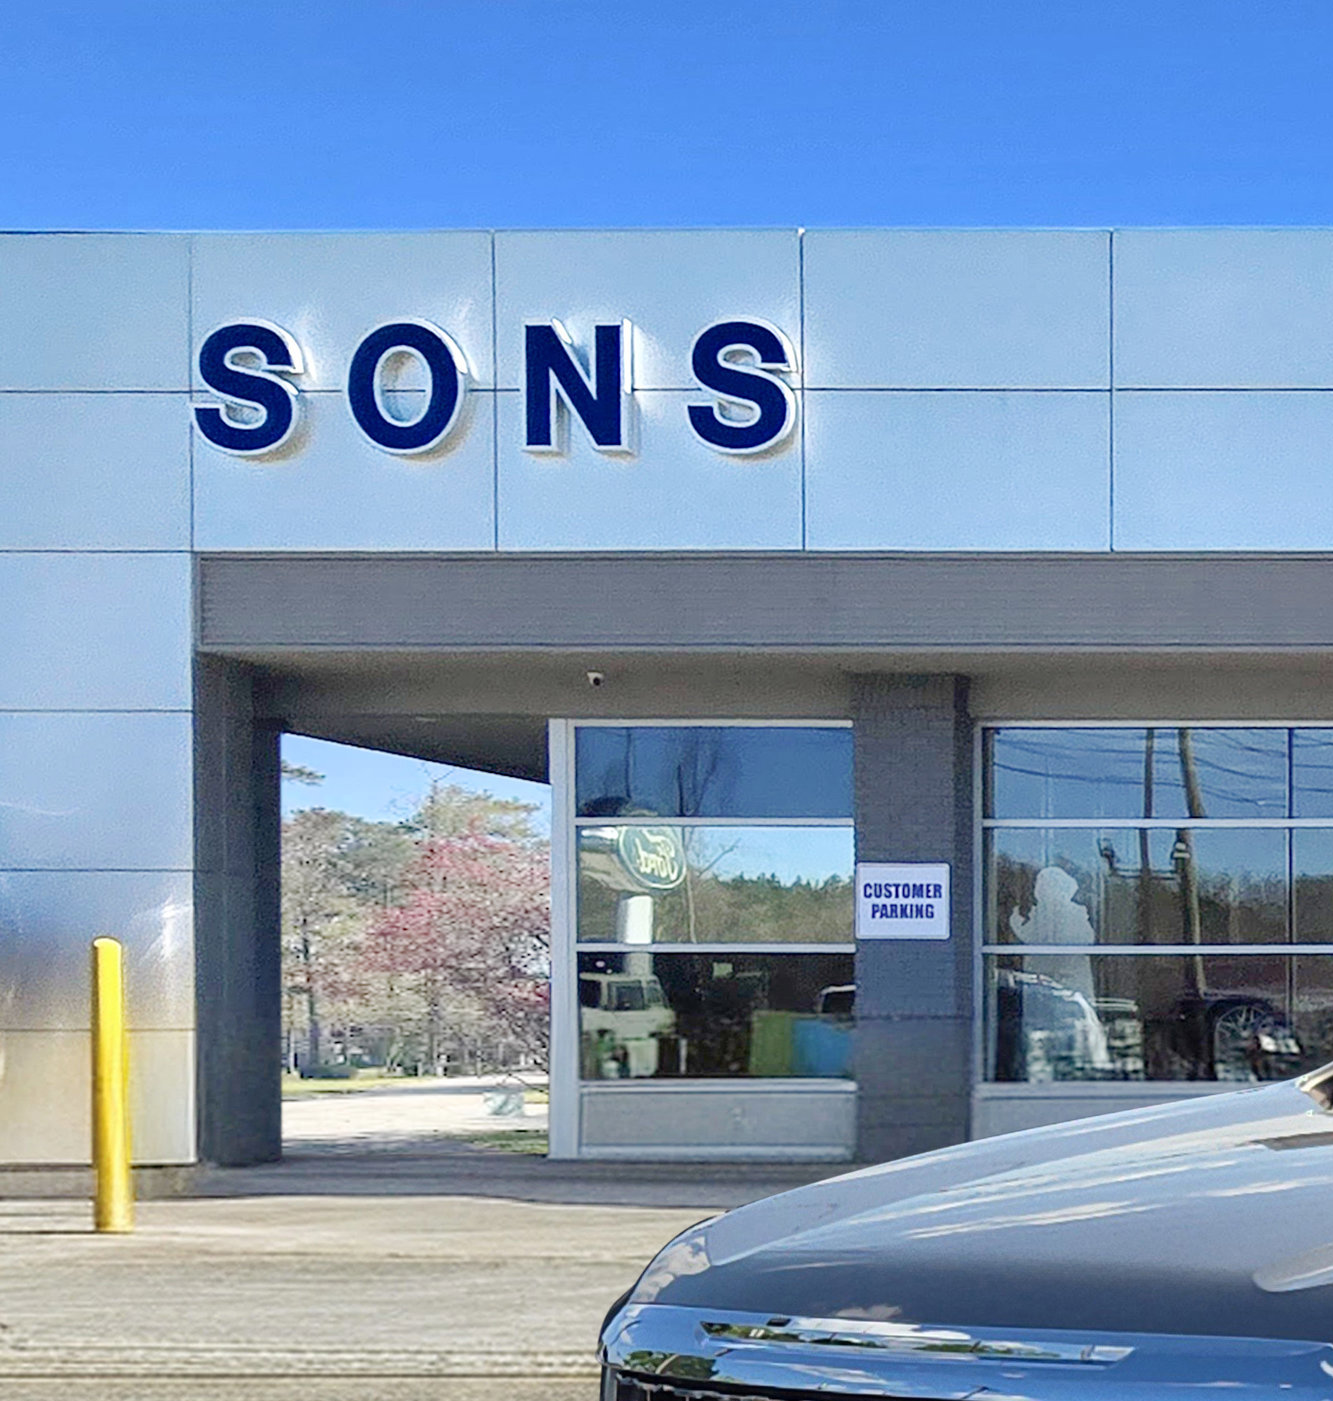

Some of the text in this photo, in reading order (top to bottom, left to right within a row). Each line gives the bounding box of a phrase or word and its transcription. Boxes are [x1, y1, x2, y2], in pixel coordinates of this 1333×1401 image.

[193, 318, 799, 454] SONS
[863, 882, 943, 899] CUSTOMER
[871, 903, 935, 919] PARKING
